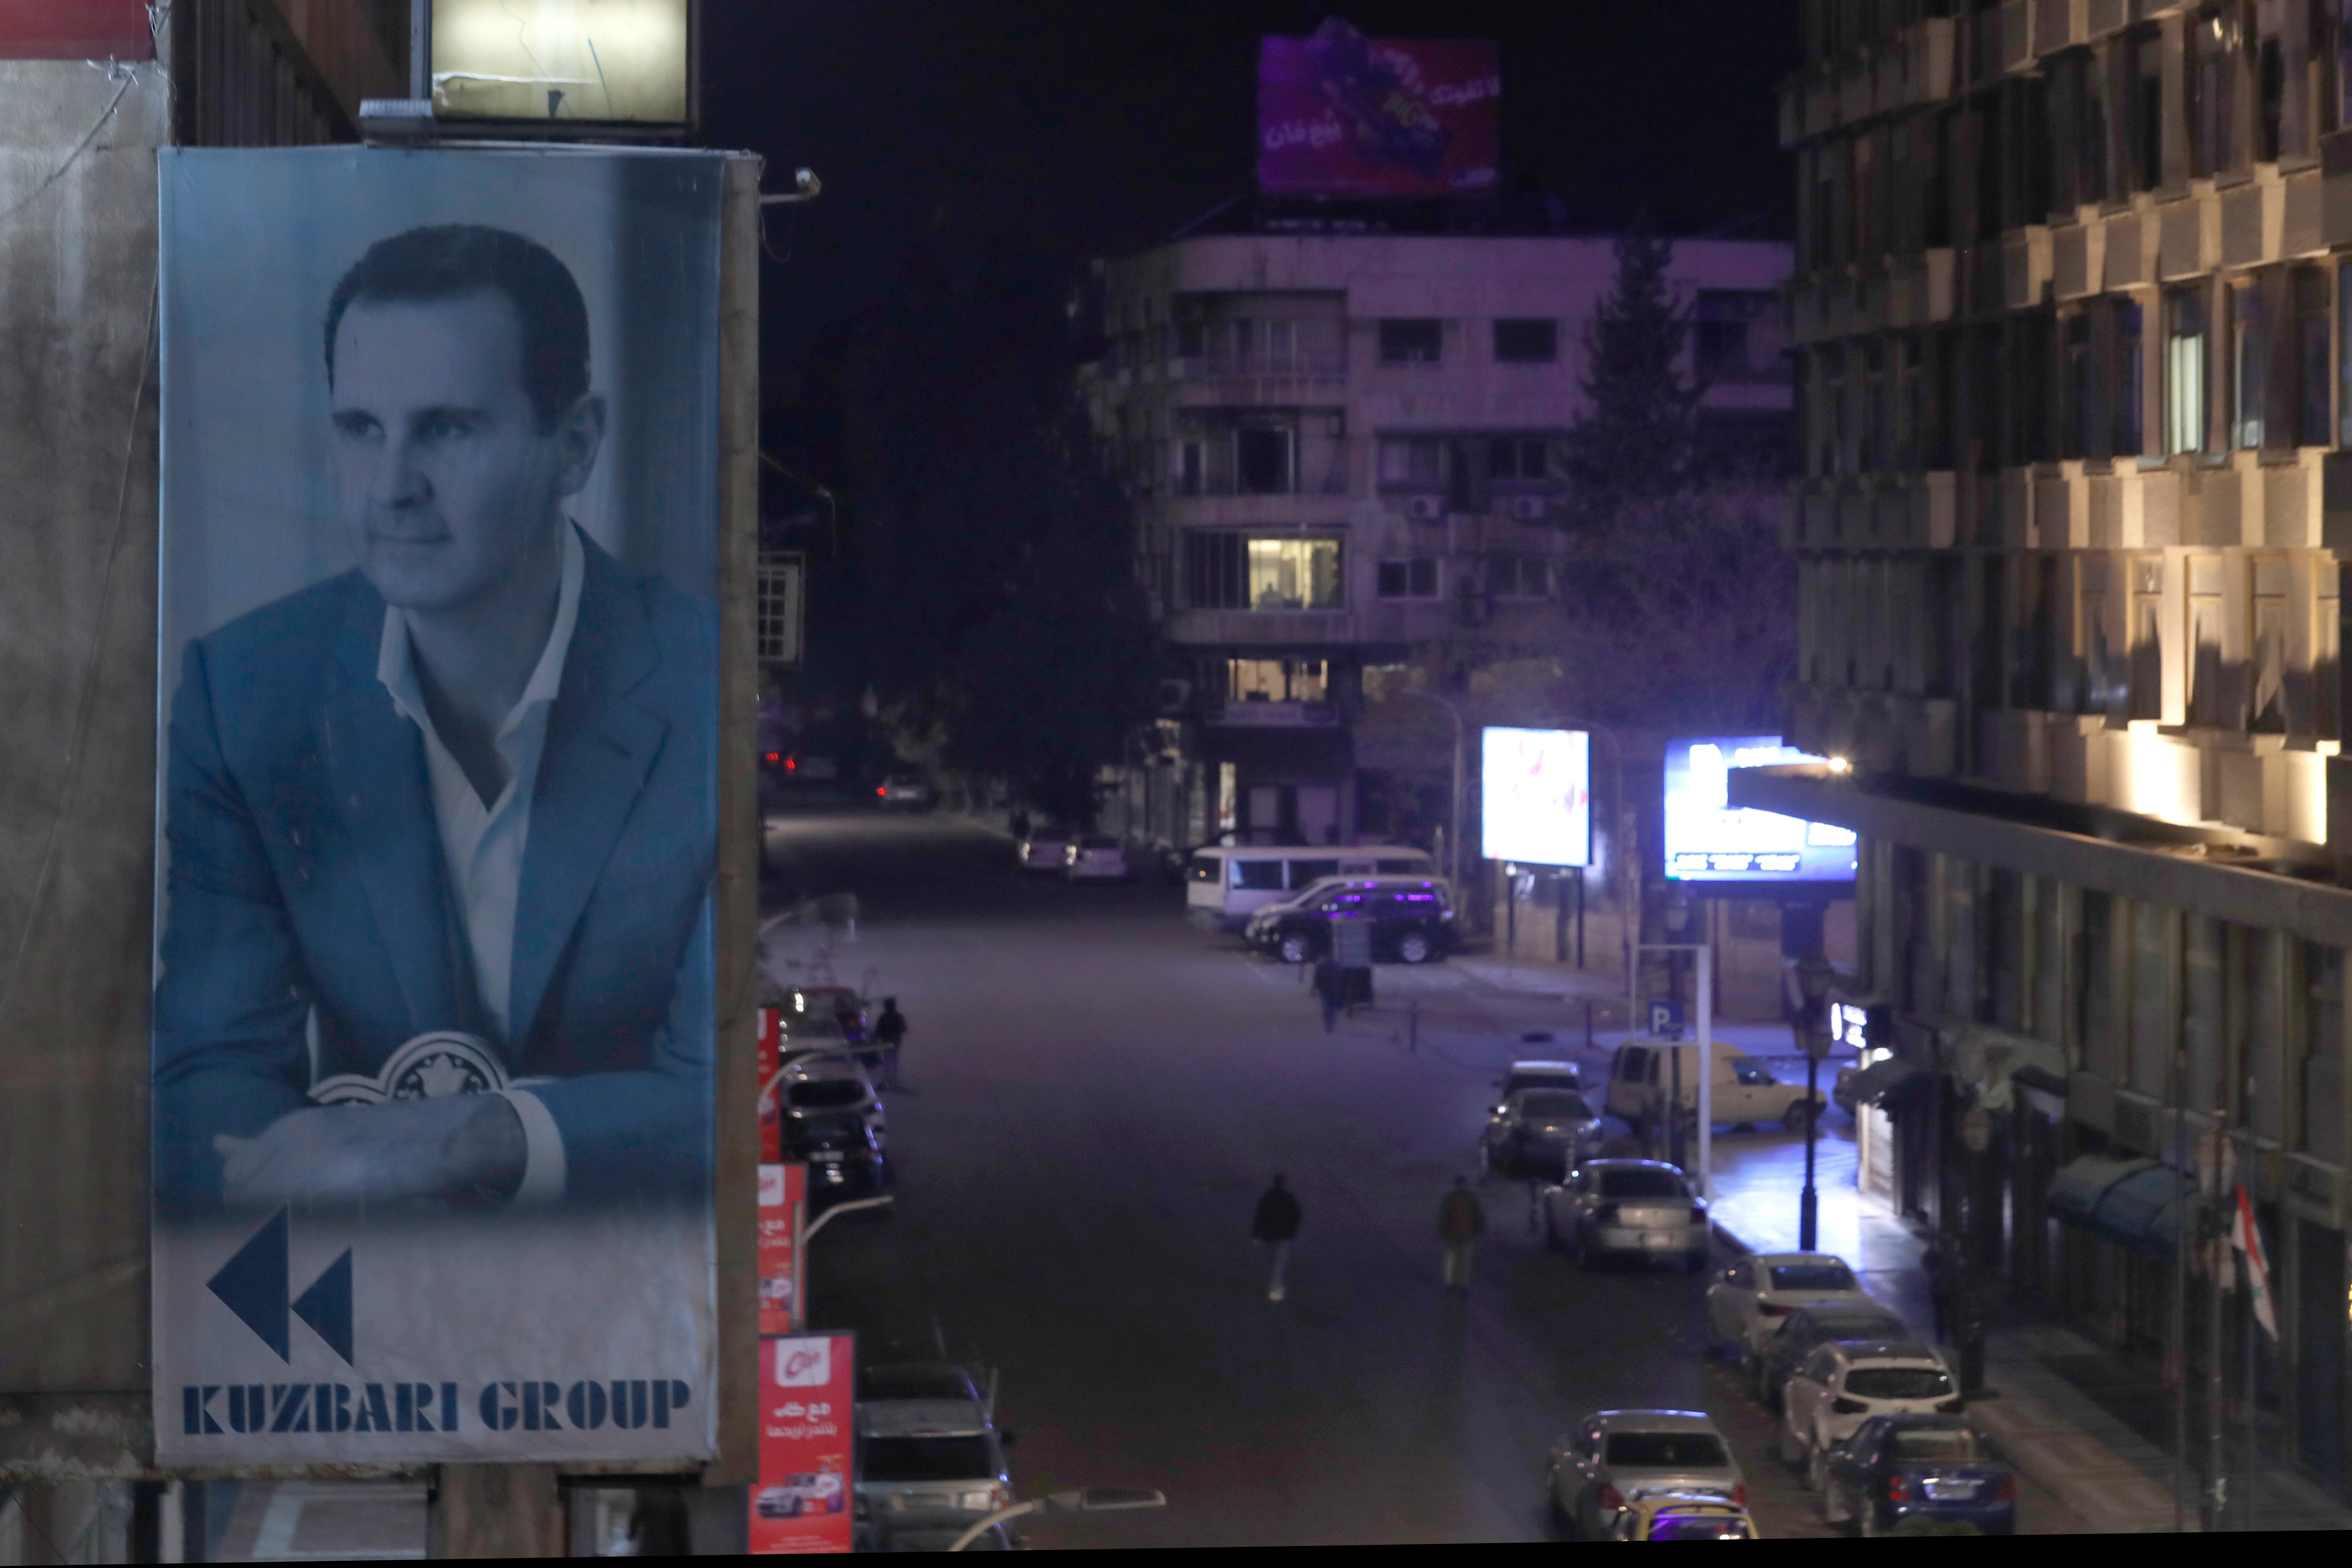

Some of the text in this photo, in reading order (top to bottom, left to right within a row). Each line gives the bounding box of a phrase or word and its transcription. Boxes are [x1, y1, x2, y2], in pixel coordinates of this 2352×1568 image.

[1652, 1007, 1671, 1032] P
[182, 1379, 691, 1435] KUZBARI GROUP
